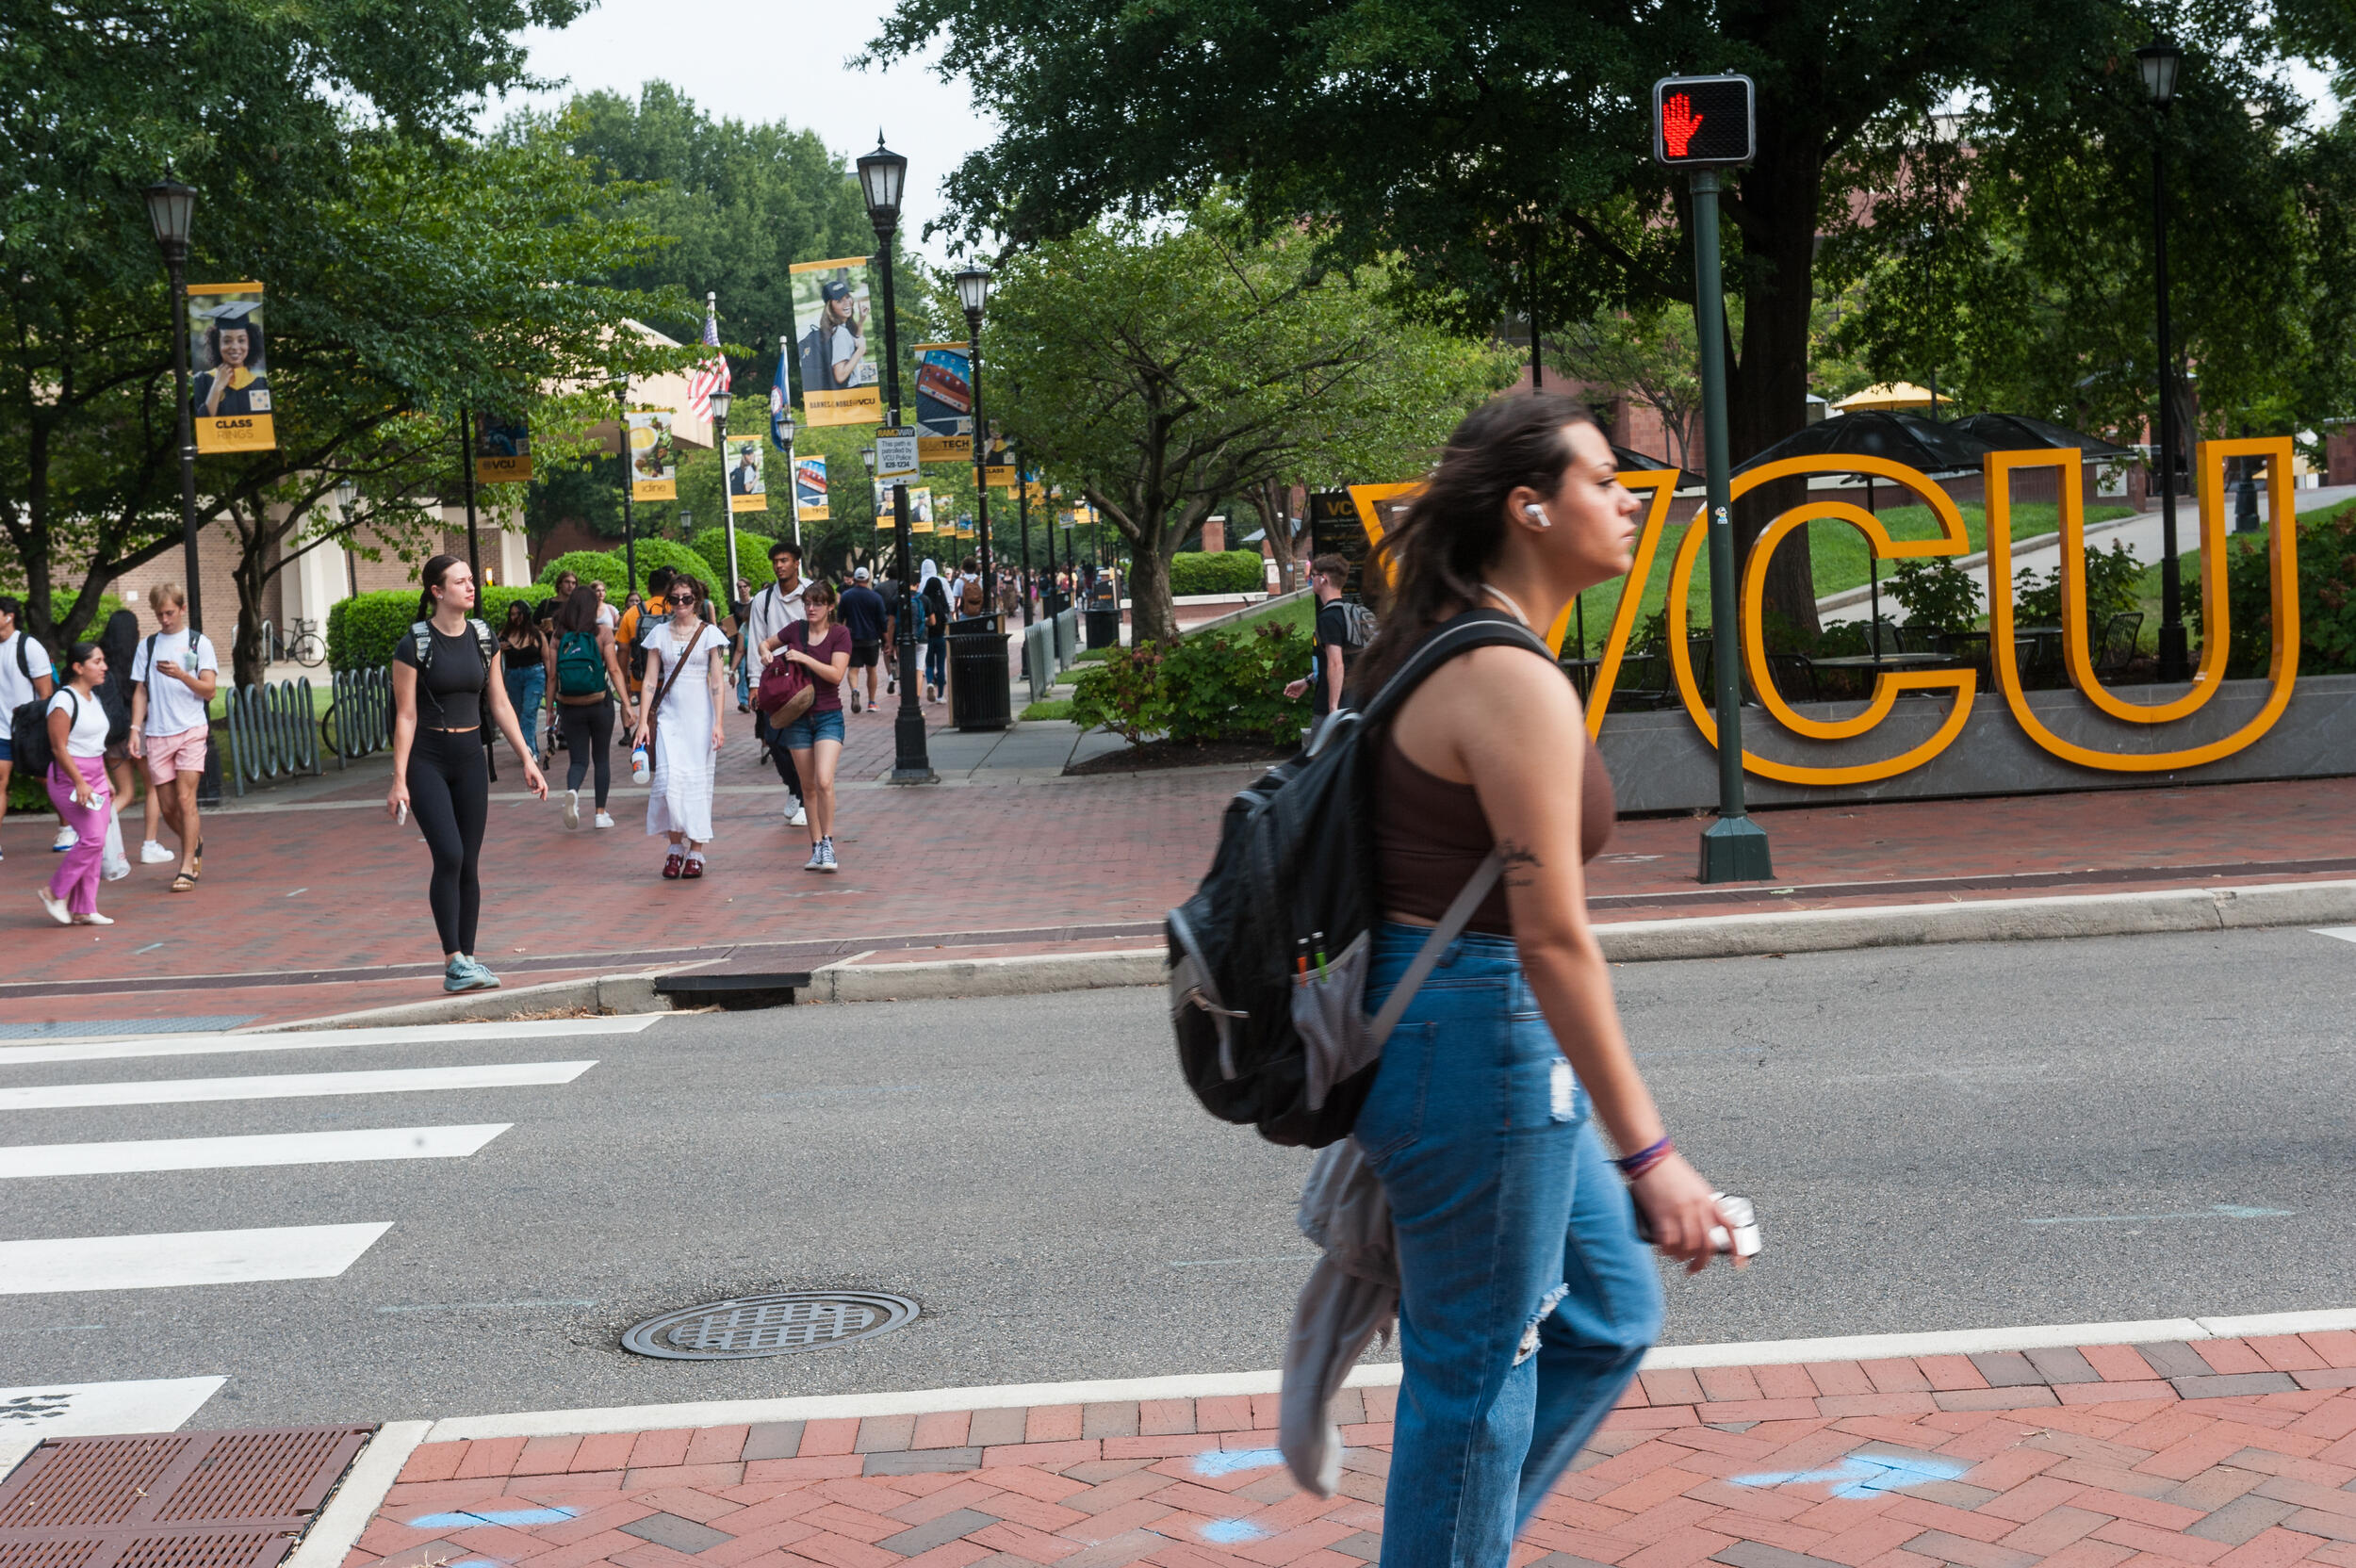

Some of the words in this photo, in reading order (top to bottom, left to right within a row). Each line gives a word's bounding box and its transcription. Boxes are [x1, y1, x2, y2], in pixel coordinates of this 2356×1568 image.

[216, 419, 253, 428] CLASS
[217, 430, 254, 439] RINGS
[893, 440, 906, 449] path
[942, 439, 970, 449] TECH
[492, 459, 516, 469] VCU
[1327, 500, 1357, 515] VC
